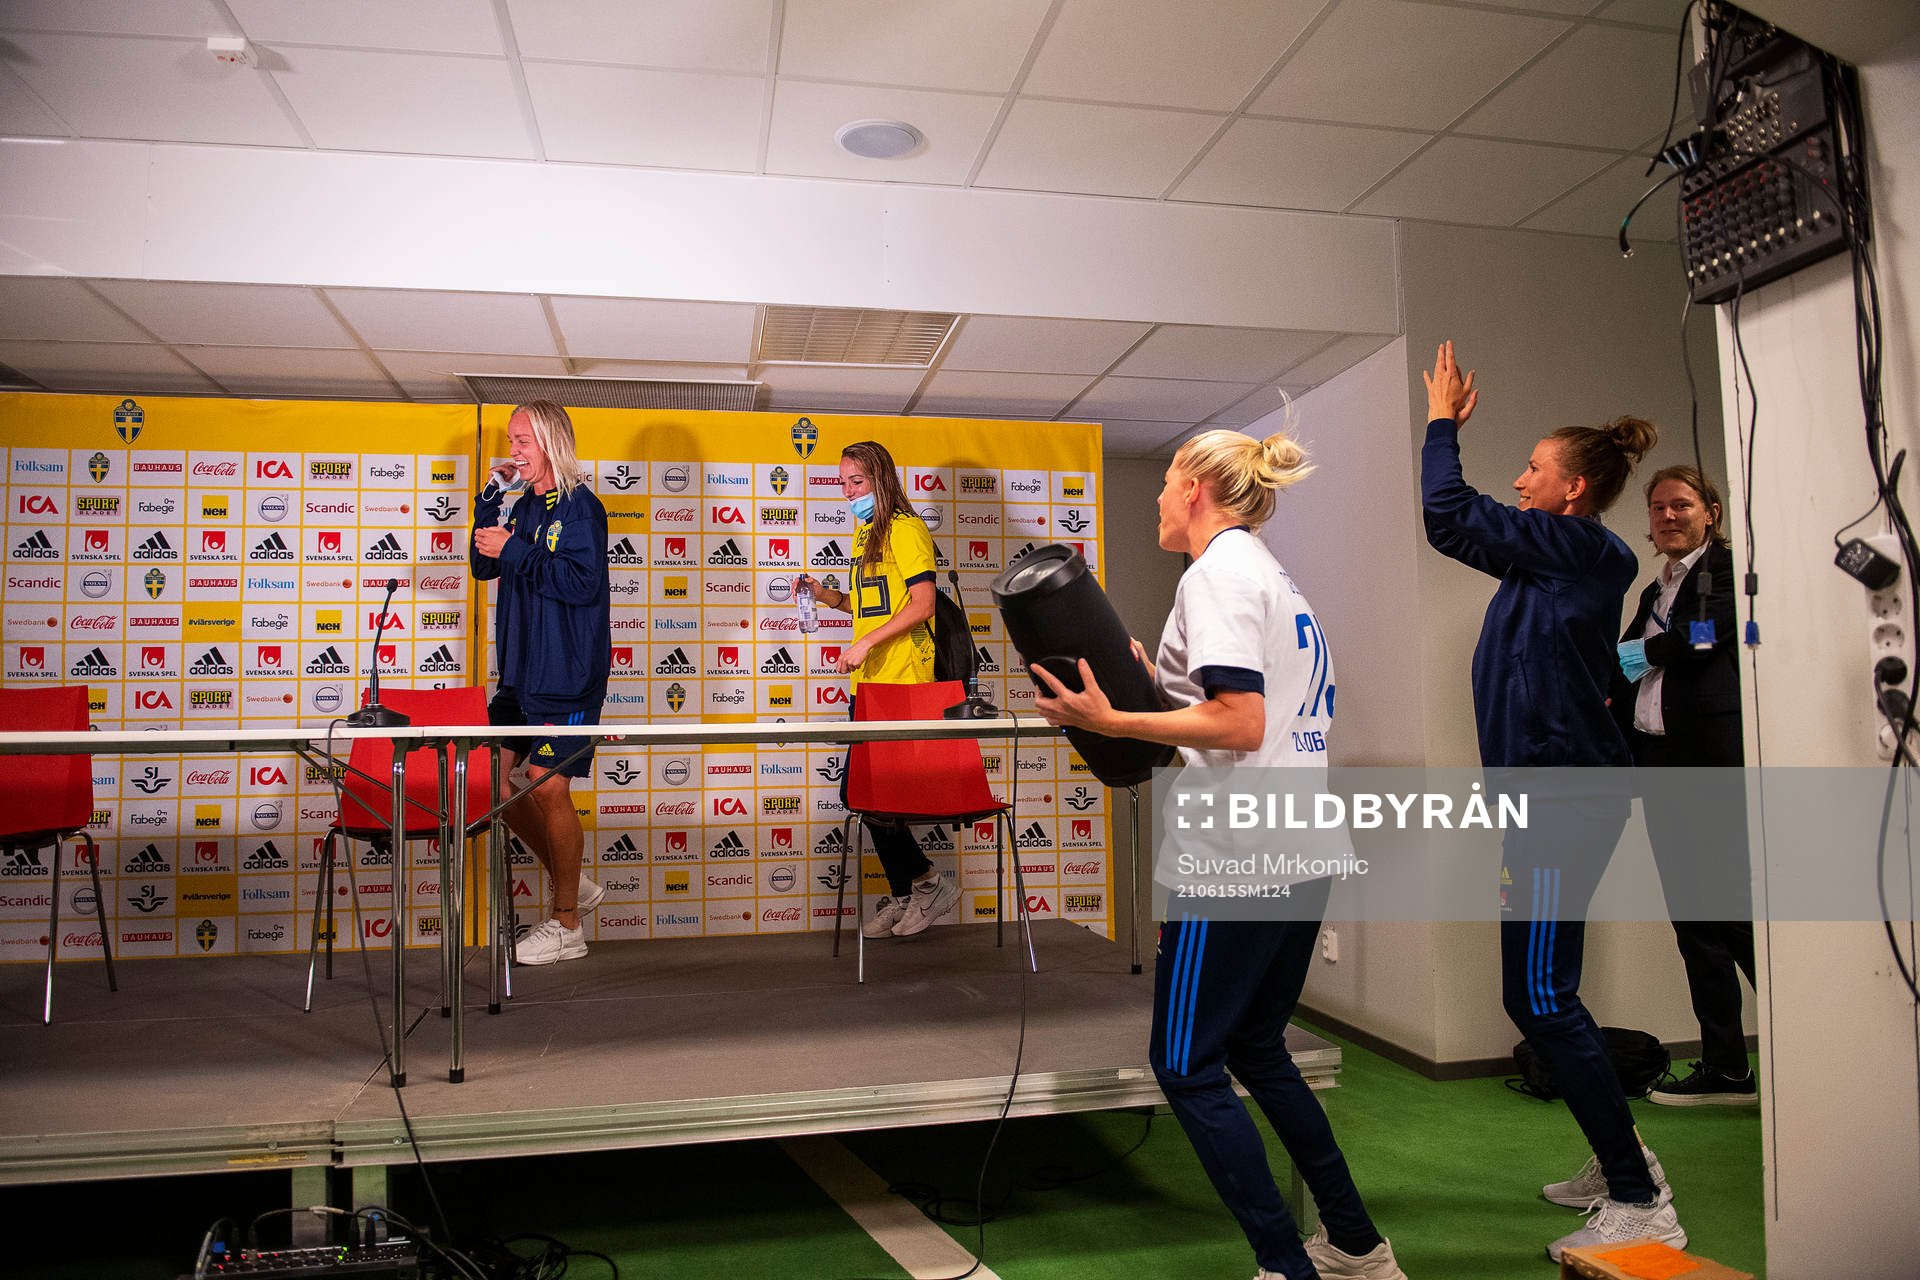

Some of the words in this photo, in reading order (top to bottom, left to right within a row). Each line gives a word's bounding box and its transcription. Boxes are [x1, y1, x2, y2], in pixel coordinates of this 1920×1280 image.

[15, 460, 64, 472] Folksam
[257, 460, 293, 478] ICA
[311, 463, 351, 475] SPORT
[617, 466, 630, 476] SJ
[370, 466, 405, 479] Fabege
[708, 474, 749, 484] Folksam
[915, 474, 947, 491] ICA
[961, 477, 996, 488] SPORT
[1011, 482, 1041, 492] Fabege
[20, 496, 59, 514] ICA
[78, 498, 119, 511] SPORT
[437, 496, 449, 508] SJ
[138, 502, 174, 514] Fabege
[306, 502, 354, 514] Scandic
[712, 506, 746, 524] ICA
[762, 509, 797, 521] SPORT
[814, 512, 846, 524] Fabege
[958, 514, 999, 524] Scandic
[1068, 510, 1080, 521] SJ
[12, 548, 59, 558] adidas
[133, 549, 178, 559] adidas
[250, 550, 294, 560] adidas
[365, 550, 408, 560] adidas
[708, 554, 748, 565] adidas
[811, 556, 850, 566] adidas
[8, 577, 61, 588] Scandic
[248, 578, 294, 588] Folksam
[706, 582, 750, 593] Scandic
[252, 618, 288, 630] Fabege
[369, 612, 404, 630] ICA
[422, 612, 460, 625] SPORT
[655, 618, 696, 628] Folksam
[71, 665, 116, 676] adidas
[190, 664, 233, 674] adidas
[306, 663, 350, 674] adidas
[420, 662, 460, 672] adidas
[656, 664, 696, 674] adidas
[760, 663, 800, 674] adidas
[135, 690, 172, 709] ICA
[190, 691, 232, 704] SPORT
[712, 692, 744, 704] Fabege
[817, 687, 850, 704] ICA
[616, 760, 628, 772] SJ
[828, 757, 840, 768] SJ
[1017, 760, 1046, 771] Fabege
[144, 767, 158, 778] SJ
[761, 764, 802, 774] Folksam
[250, 766, 288, 785] ICA
[1075, 786, 1088, 798] SJ
[601, 805, 644, 813] BAUHAUS
[714, 798, 747, 816] ICA
[764, 798, 800, 810] SPORT
[131, 814, 167, 826] Fabege
[602, 850, 644, 861] adidas
[710, 848, 750, 858] adidas
[125, 862, 170, 872] adidas
[244, 858, 288, 870] adidas
[2, 865, 48, 876] adidas
[708, 875, 752, 886] Scandic
[142, 886, 155, 897] SJ
[606, 881, 640, 892] Fabege
[242, 889, 290, 900] Folksam
[0, 896, 51, 906] Scandic
[1066, 896, 1101, 907] SPORT
[600, 916, 646, 928] Scandic
[656, 914, 698, 926] Folksam
[123, 933, 172, 942] BAUHAUS
[248, 929, 284, 942] Fabege
